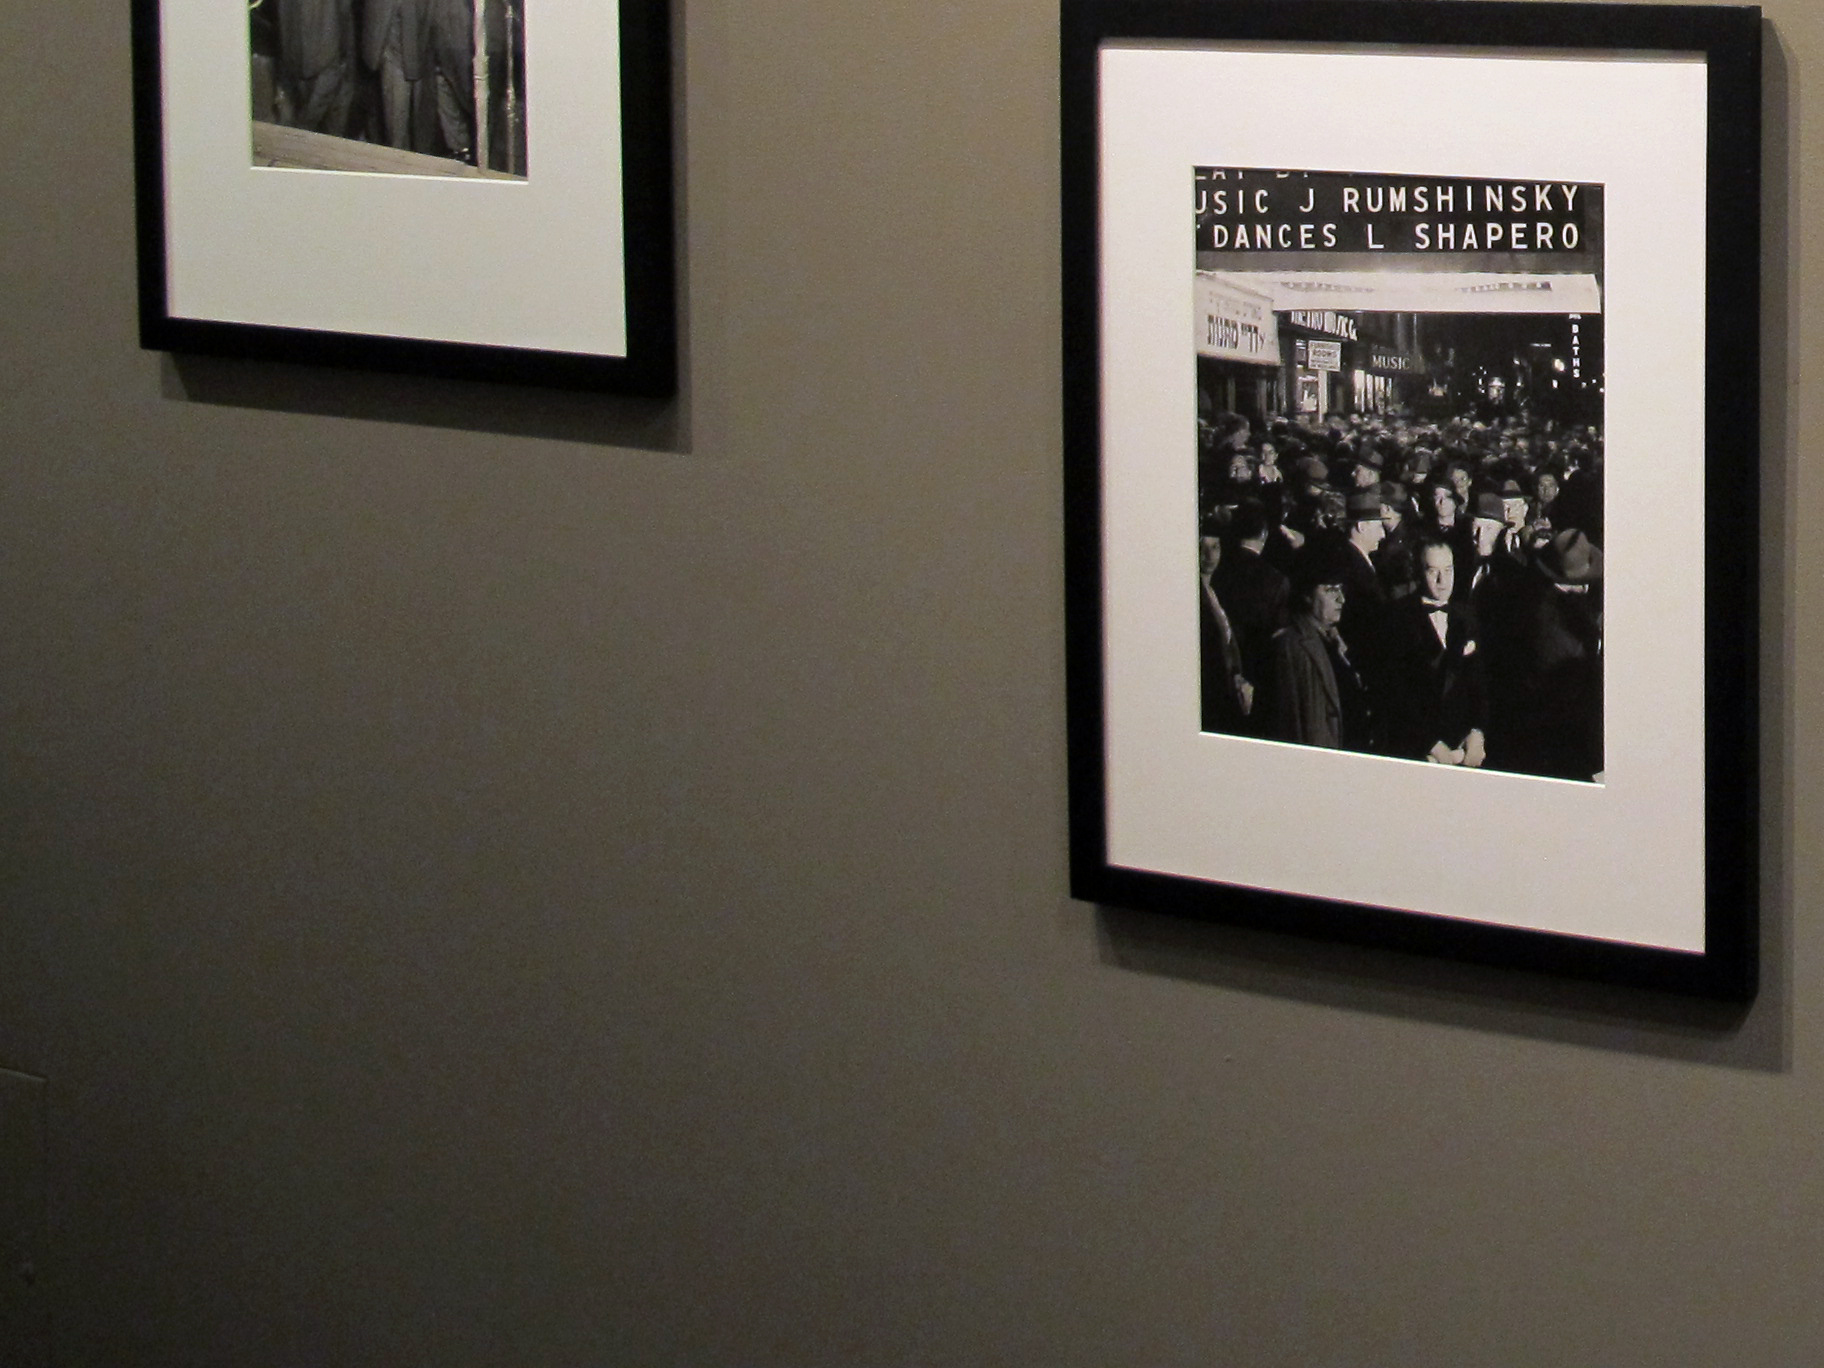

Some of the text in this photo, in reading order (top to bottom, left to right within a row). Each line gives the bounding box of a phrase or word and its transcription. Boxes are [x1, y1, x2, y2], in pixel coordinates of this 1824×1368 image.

[1300, 187, 1315, 213] J
[1342, 184, 1578, 214] RUMSHINSKY
[1213, 222, 1580, 250] DANCES L SHAPERO
[1372, 354, 1410, 371] MUSIC
